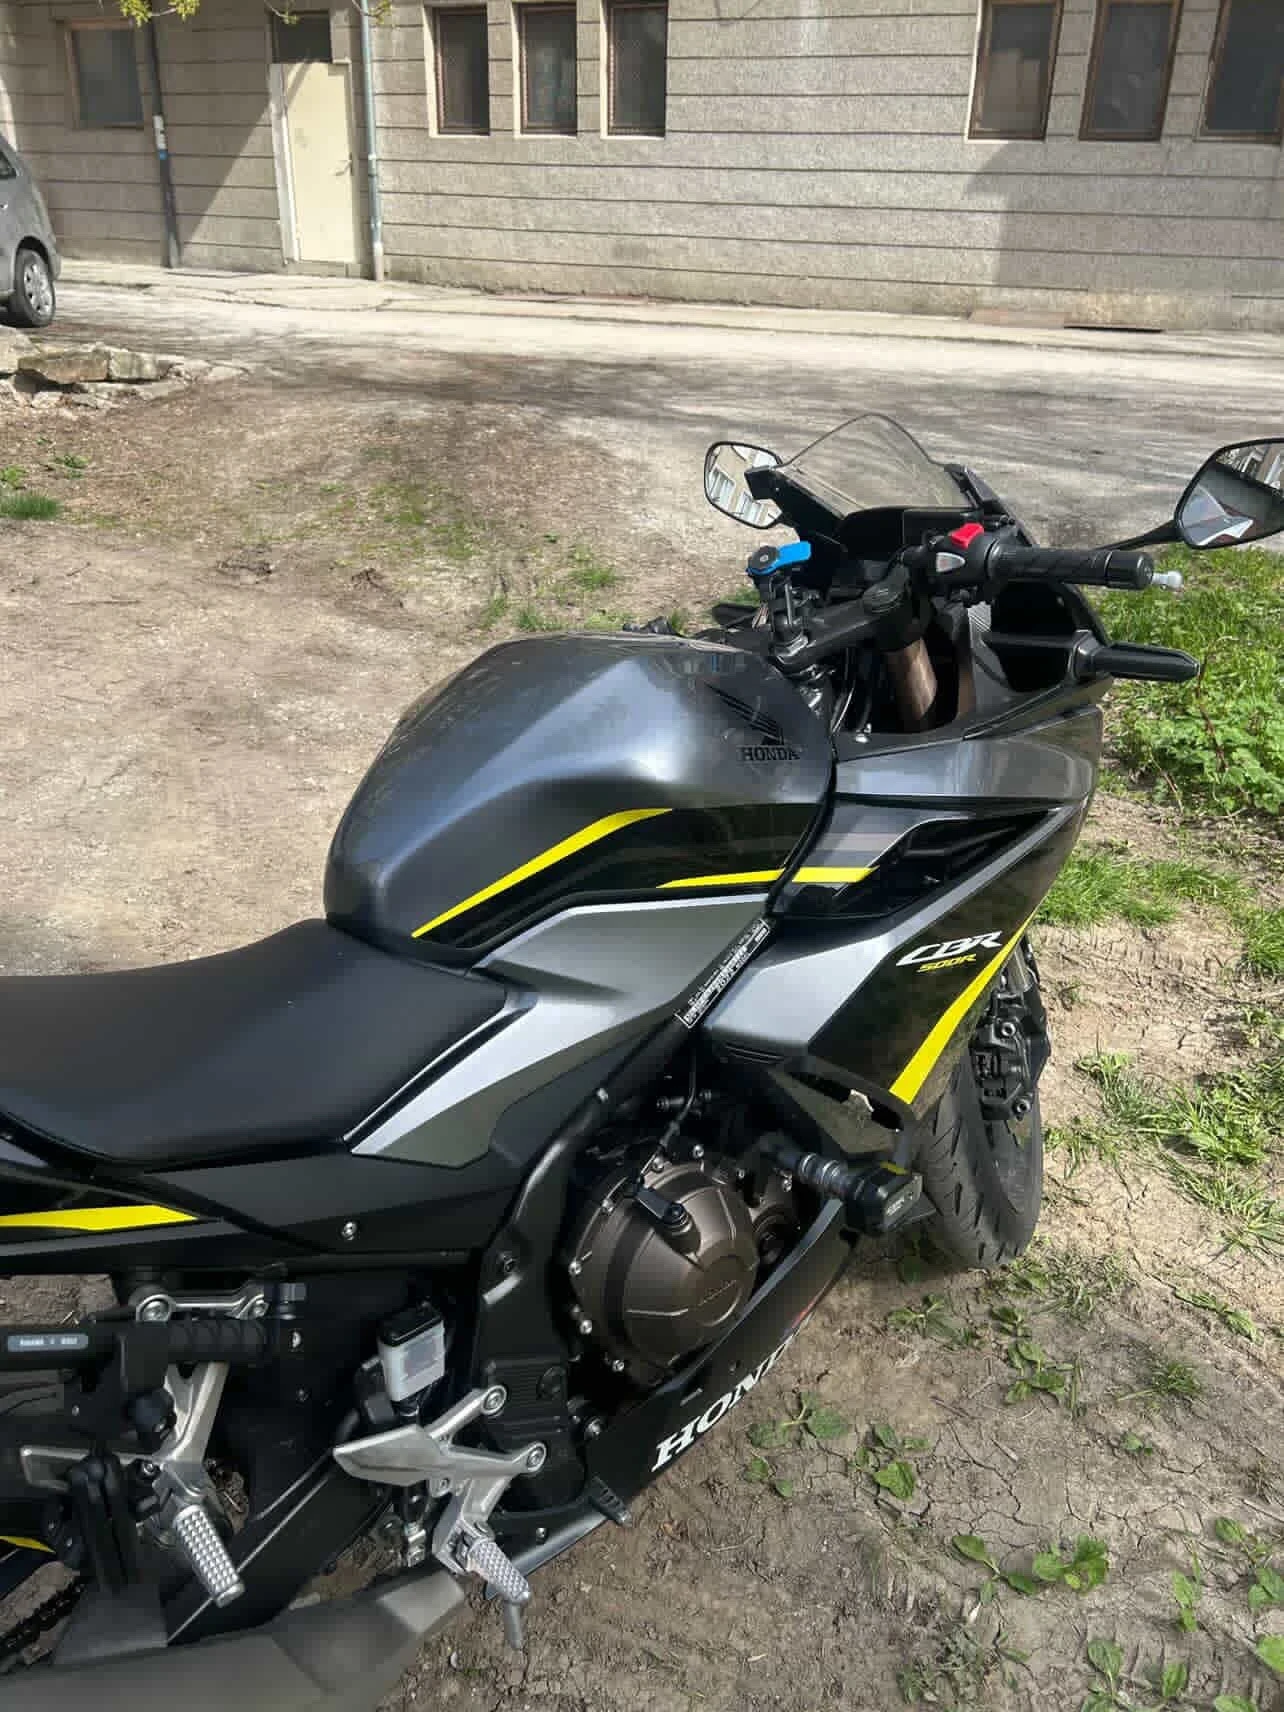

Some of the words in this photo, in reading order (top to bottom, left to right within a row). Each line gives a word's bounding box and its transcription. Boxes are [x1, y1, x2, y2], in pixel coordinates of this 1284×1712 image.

[741, 746, 801, 761] HONDA
[896, 930, 1002, 966] CBR
[916, 953, 977, 973] 500R
